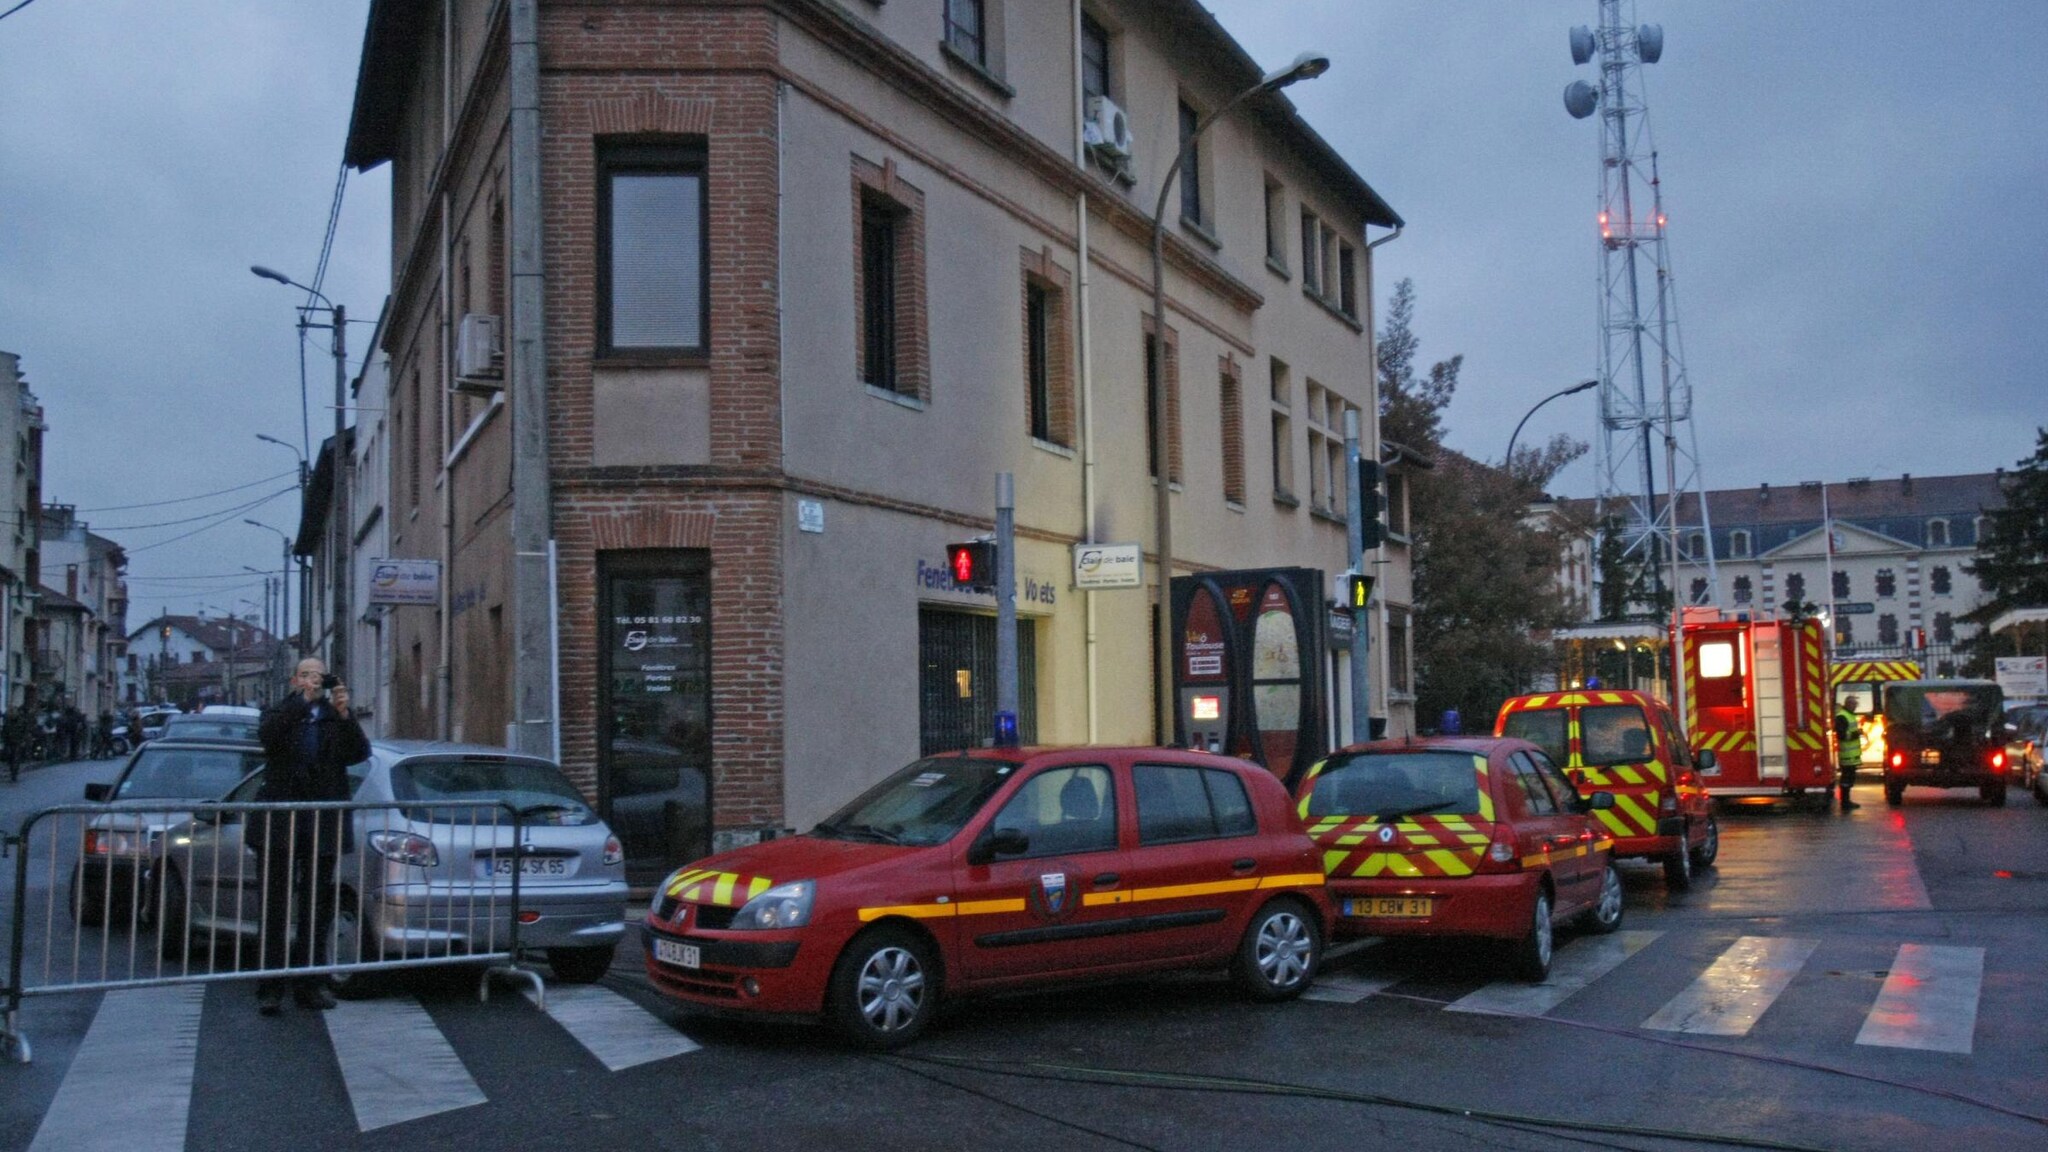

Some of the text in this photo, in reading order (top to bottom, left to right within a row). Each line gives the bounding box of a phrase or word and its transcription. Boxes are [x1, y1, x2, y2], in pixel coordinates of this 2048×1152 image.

[634, 616, 646, 624] 05
[689, 616, 702, 624] 30
[494, 860, 565, 875] 454 SK 65
[1358, 900, 1427, 914] 13 CBW 31
